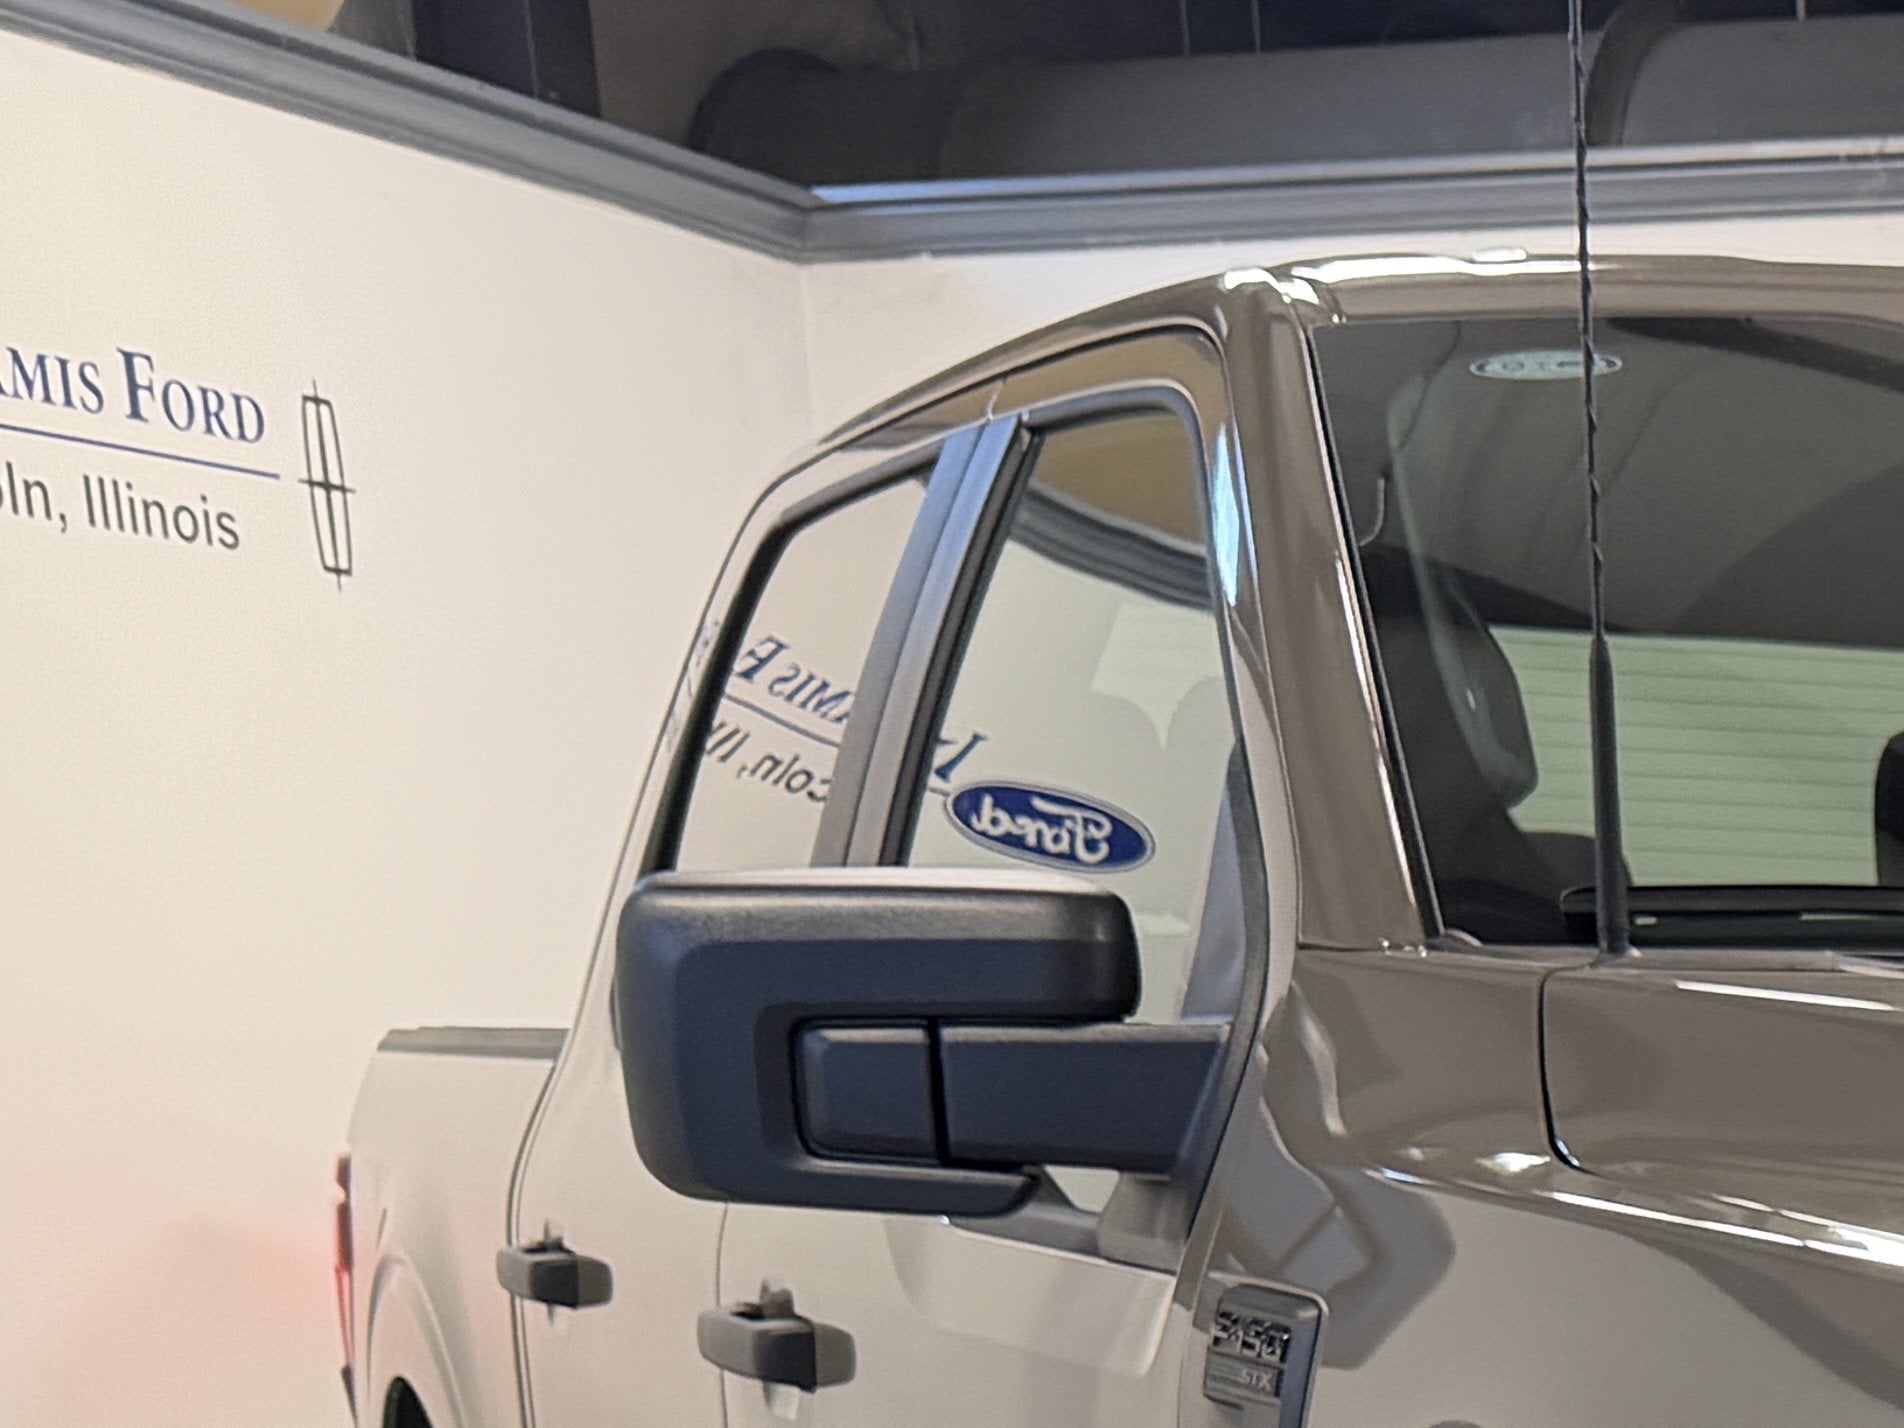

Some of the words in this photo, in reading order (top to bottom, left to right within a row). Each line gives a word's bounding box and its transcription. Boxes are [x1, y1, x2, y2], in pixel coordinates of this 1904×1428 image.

[0, 346, 104, 414] MIS
[116, 347, 265, 443] FORD
[83, 473, 240, 551] Illinois
